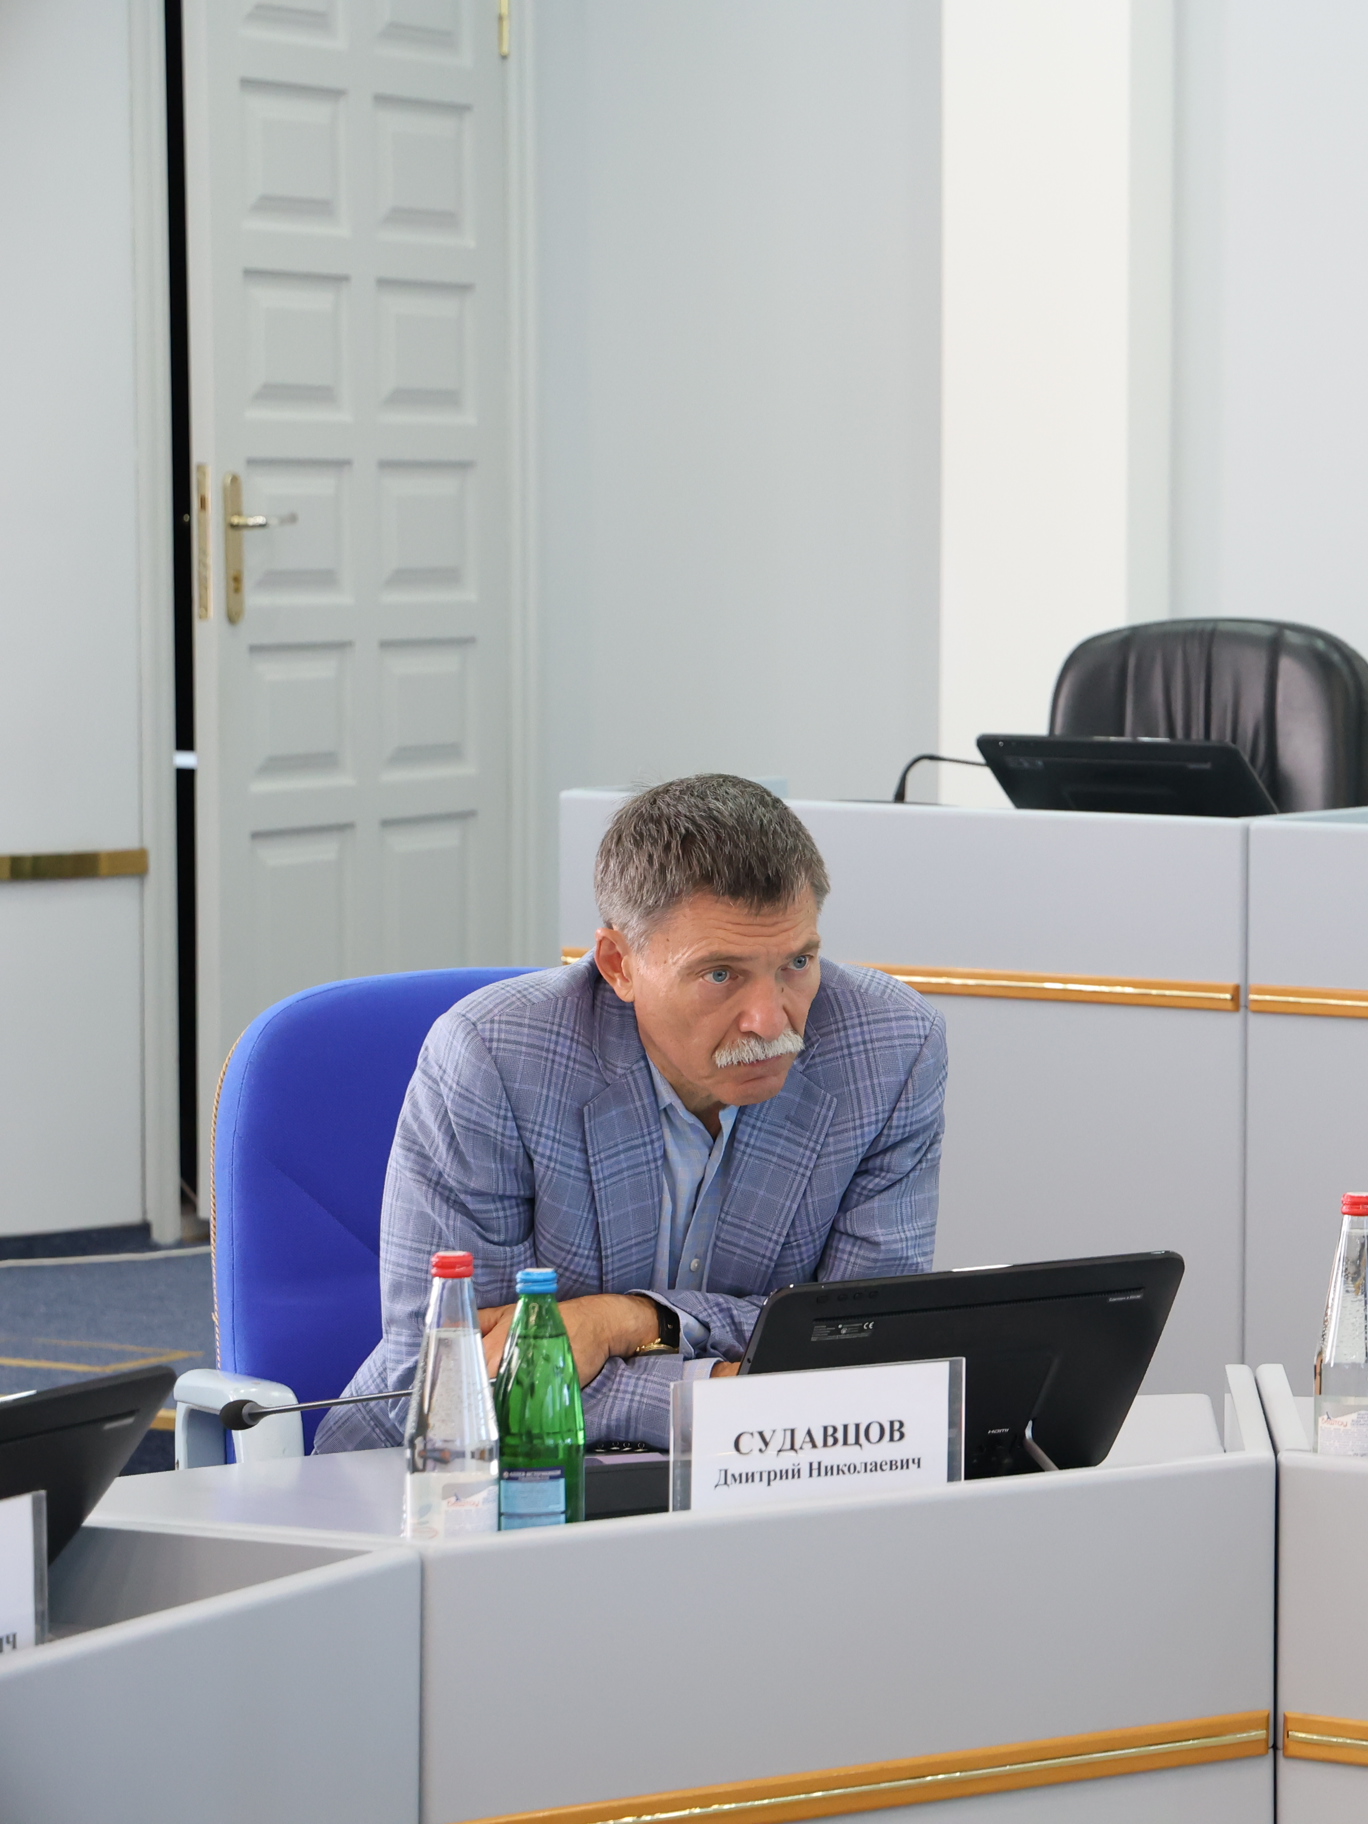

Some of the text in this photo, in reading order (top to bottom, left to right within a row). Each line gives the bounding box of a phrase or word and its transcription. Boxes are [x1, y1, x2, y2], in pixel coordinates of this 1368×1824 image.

[733, 1419, 906, 1456] СУДАВЦОВ
[714, 1457, 922, 1489] Дмитрий Николаевич
